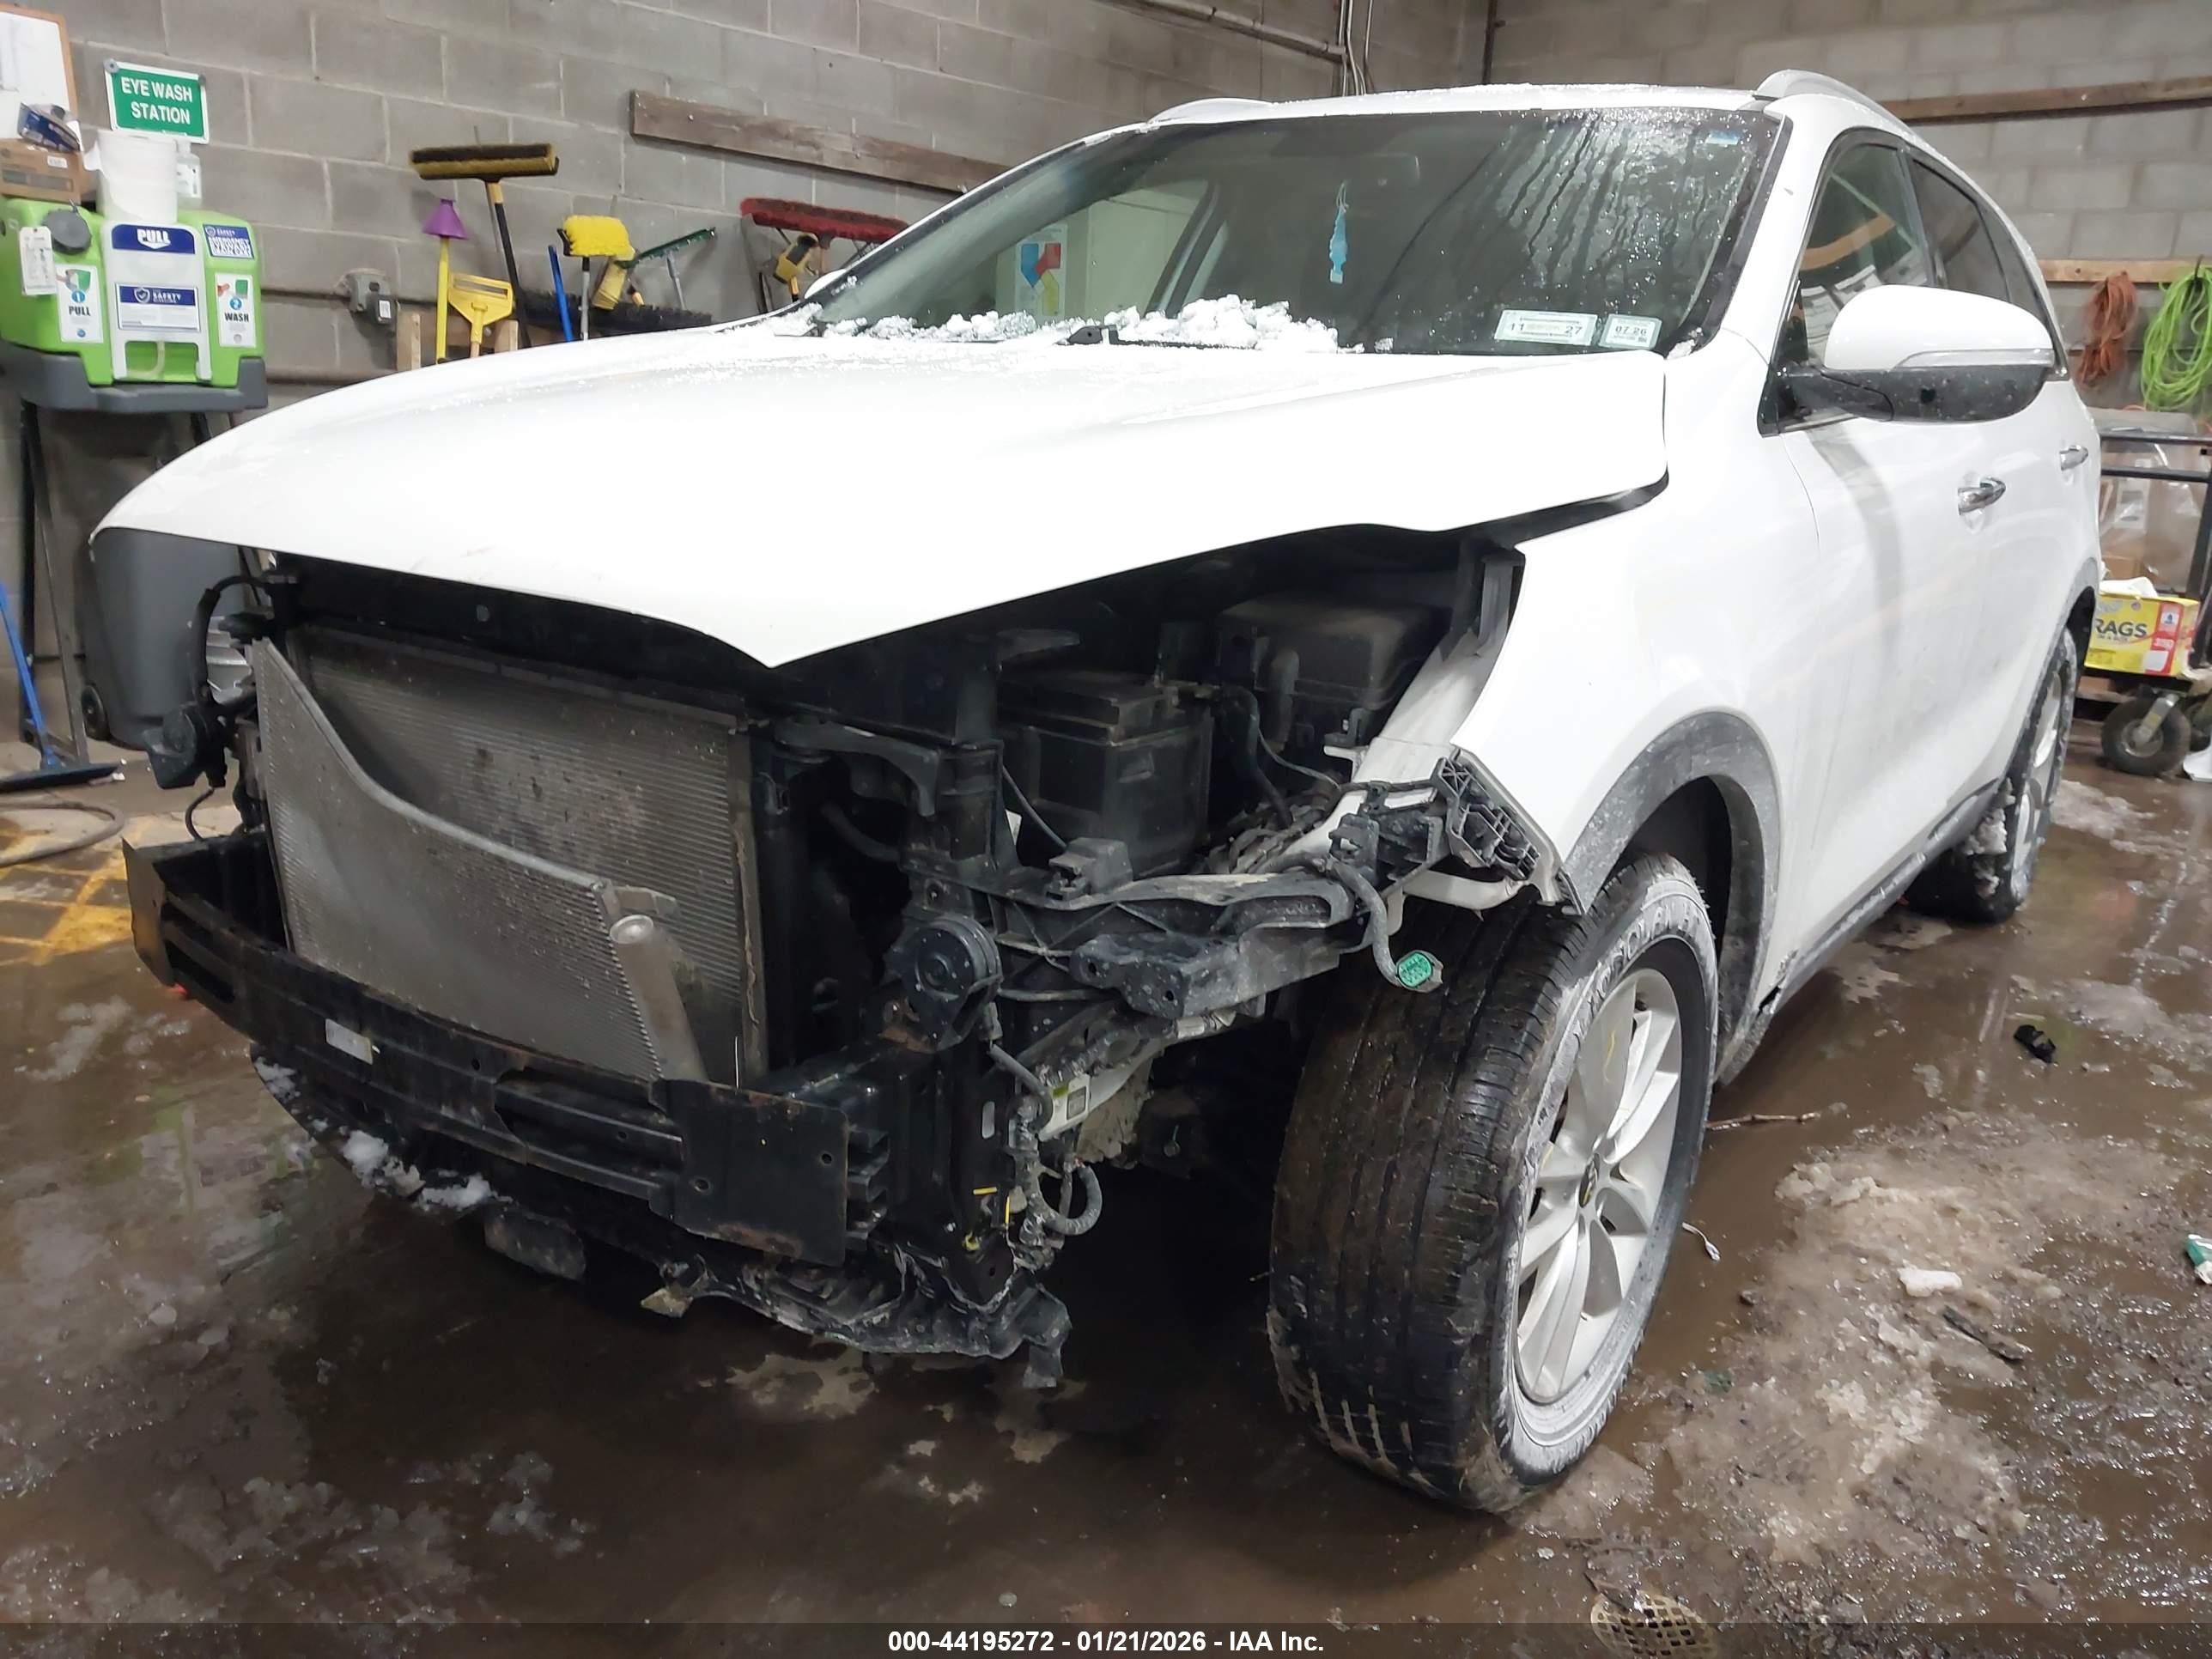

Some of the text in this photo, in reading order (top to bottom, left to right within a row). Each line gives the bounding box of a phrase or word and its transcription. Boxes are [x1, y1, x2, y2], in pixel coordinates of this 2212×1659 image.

[121, 76, 192, 102] EYE WASH
[131, 101, 191, 125] STATION
[137, 228, 170, 244] PULL
[69, 306, 91, 316] PULL
[225, 313, 249, 322] WASH
[1565, 325, 1583, 335] 27
